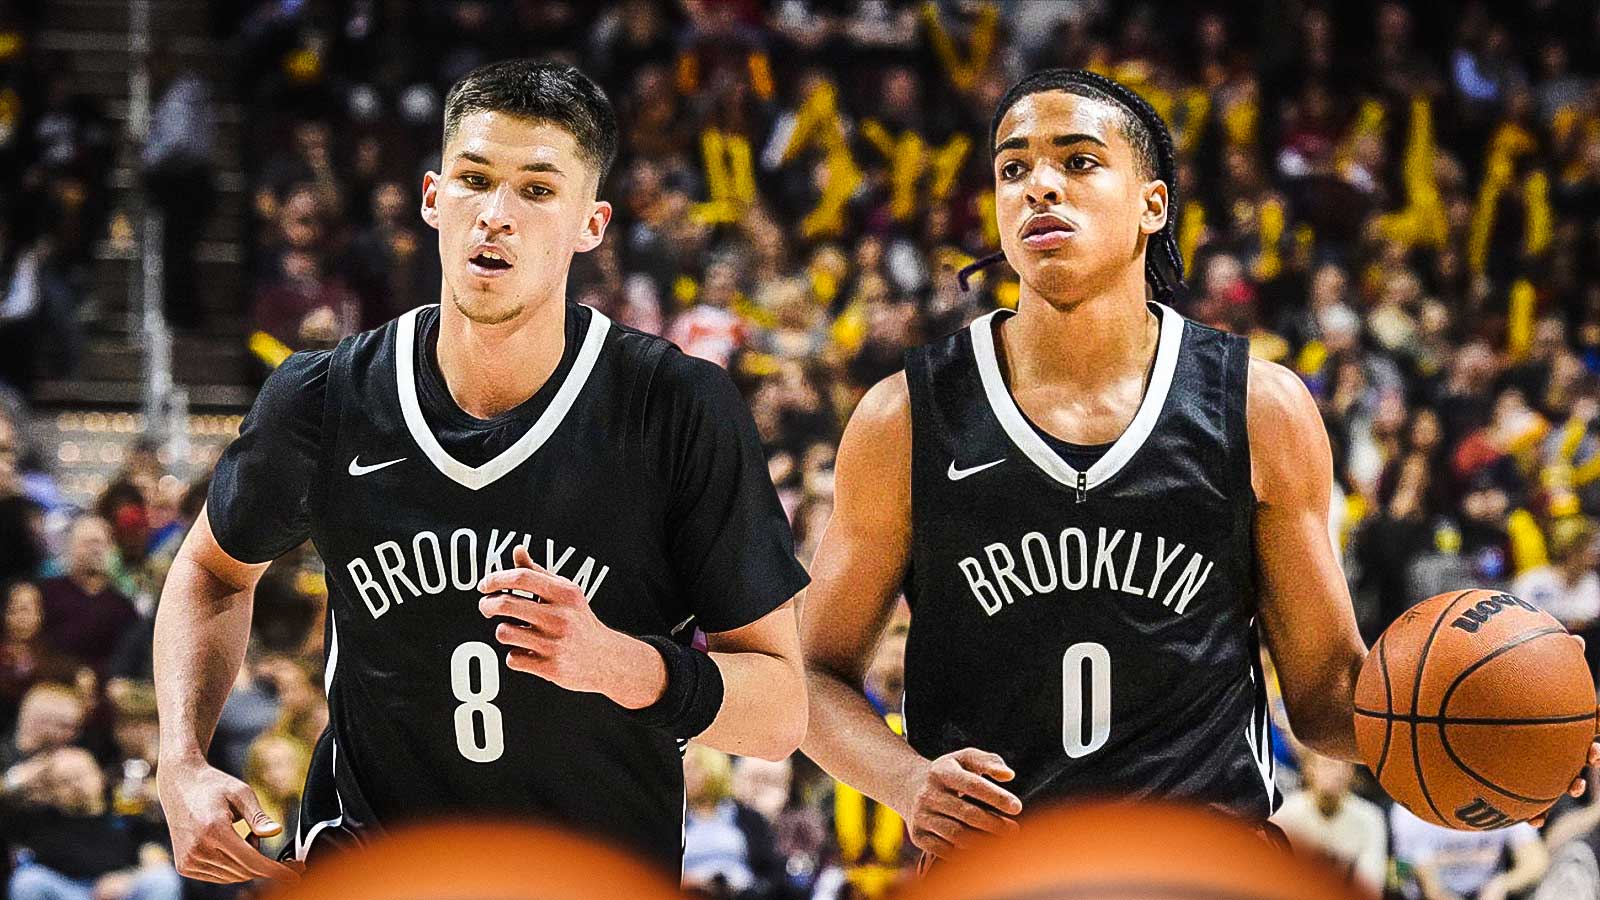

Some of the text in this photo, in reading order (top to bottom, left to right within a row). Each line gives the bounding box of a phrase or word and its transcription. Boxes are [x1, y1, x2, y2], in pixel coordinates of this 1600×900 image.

[958, 527, 1214, 616] BROOKLYN
[450, 641, 504, 763] 8
[1062, 642, 1111, 758] 0
